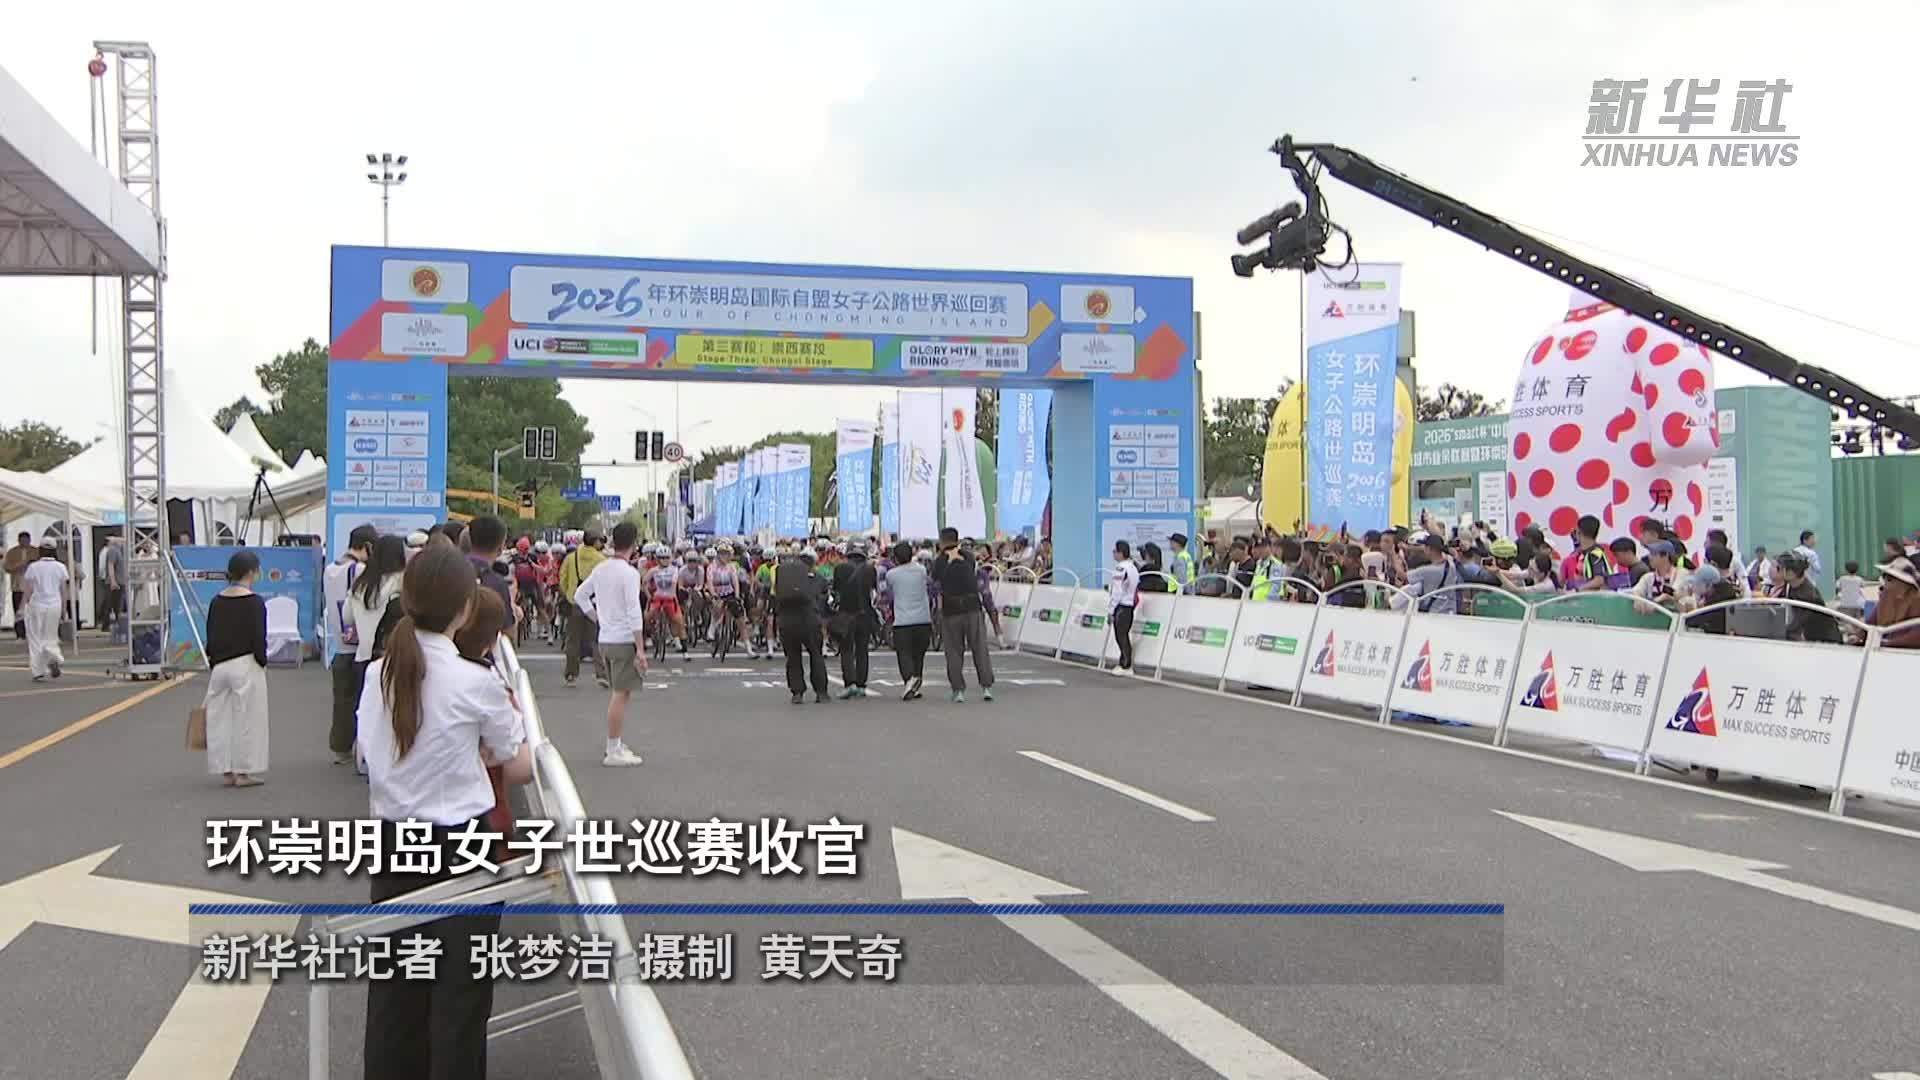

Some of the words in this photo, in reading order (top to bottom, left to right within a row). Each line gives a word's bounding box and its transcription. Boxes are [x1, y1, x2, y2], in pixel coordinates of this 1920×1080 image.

[648, 308, 703, 319] TOUR
[727, 310, 751, 320] OF
[774, 312, 905, 325] CHONGMING
[930, 317, 1009, 329] ISLAND
[514, 338, 540, 350] UCI
[909, 345, 948, 355] GLORY
[949, 346, 977, 356] WITH
[909, 356, 949, 367] RIDING
[1352, 353, 1380, 465] 环崇明岛
[1535, 403, 1584, 417] SPORTS
[1323, 351, 1344, 507] 女子公路世巡赛
[667, 447, 679, 457] 40
[1440, 652, 1507, 680] 万胜体育
[1567, 666, 1650, 698] 万胜体育
[1579, 697, 1611, 712] SUCCESS
[1613, 701, 1642, 716] SPORTS
[1727, 685, 1840, 724] 万胜体育
[1722, 717, 1743, 730] MAX
[1744, 720, 1788, 738] SUCCESS
[1789, 727, 1832, 744] SPORTS
